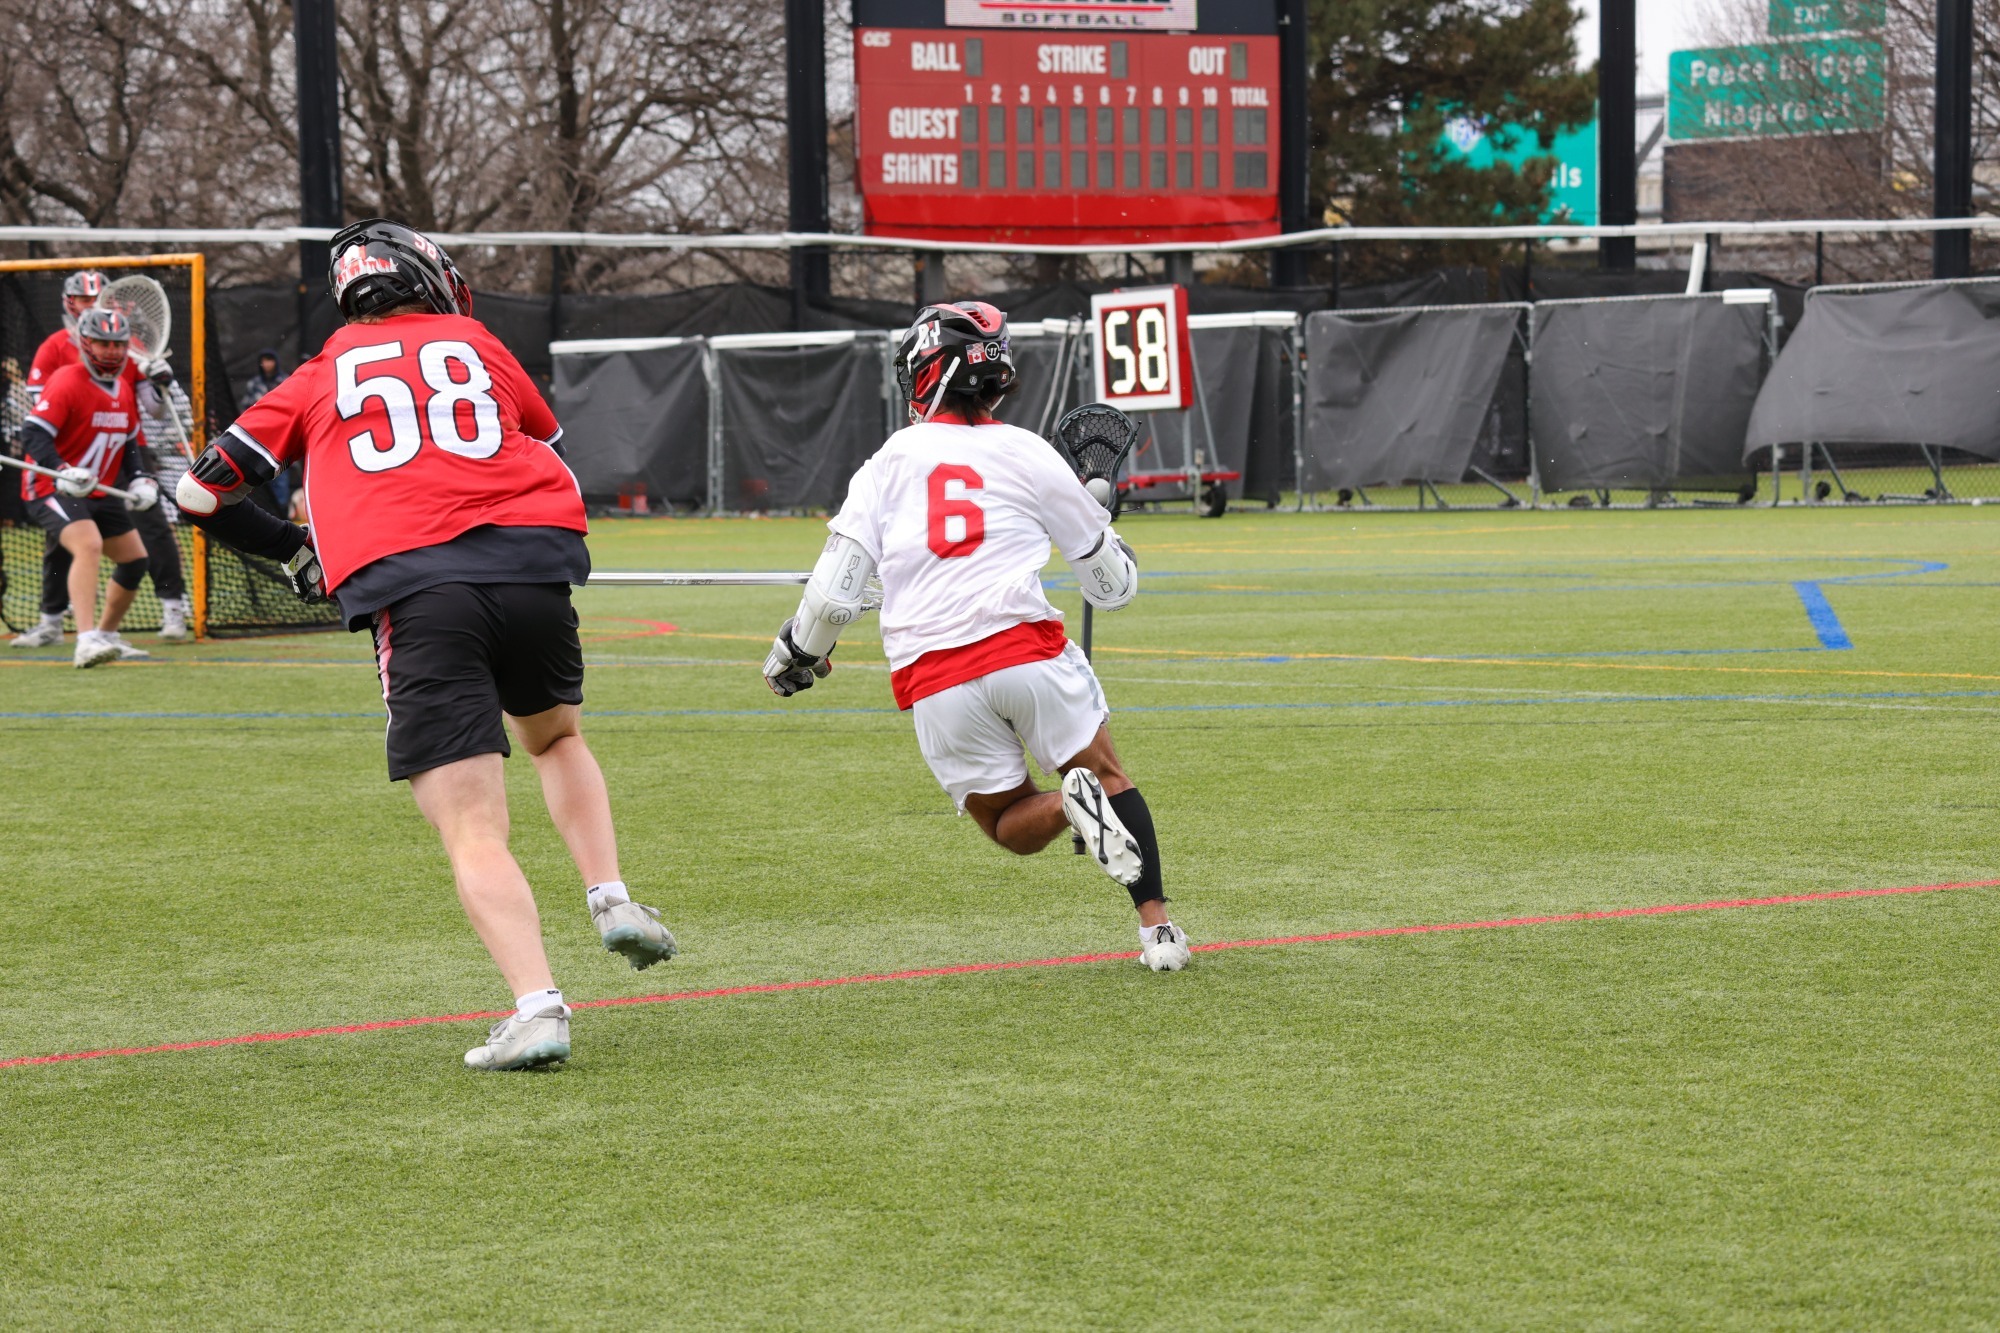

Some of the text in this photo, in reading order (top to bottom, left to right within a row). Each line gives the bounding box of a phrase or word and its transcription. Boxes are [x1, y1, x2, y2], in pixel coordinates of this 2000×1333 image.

[1002, 13, 1145, 25] SOFTBALL
[911, 42, 961, 71] BALL
[1038, 45, 1106, 74] STRIKE
[1188, 47, 1226, 75] OUT
[1690, 60, 1766, 87] Peace
[964, 84, 1269, 106] 1 2 3 4 5 6 7 8 9 10 TOTAL
[889, 107, 958, 139] GUEST
[1704, 100, 1808, 132] Niagara
[413, 233, 437, 260] 58
[1105, 308, 1168, 395] 58
[336, 340, 502, 472] 58
[76, 431, 127, 482] 47
[926, 462, 987, 559] 6
[1091, 566, 1113, 594] EVO
